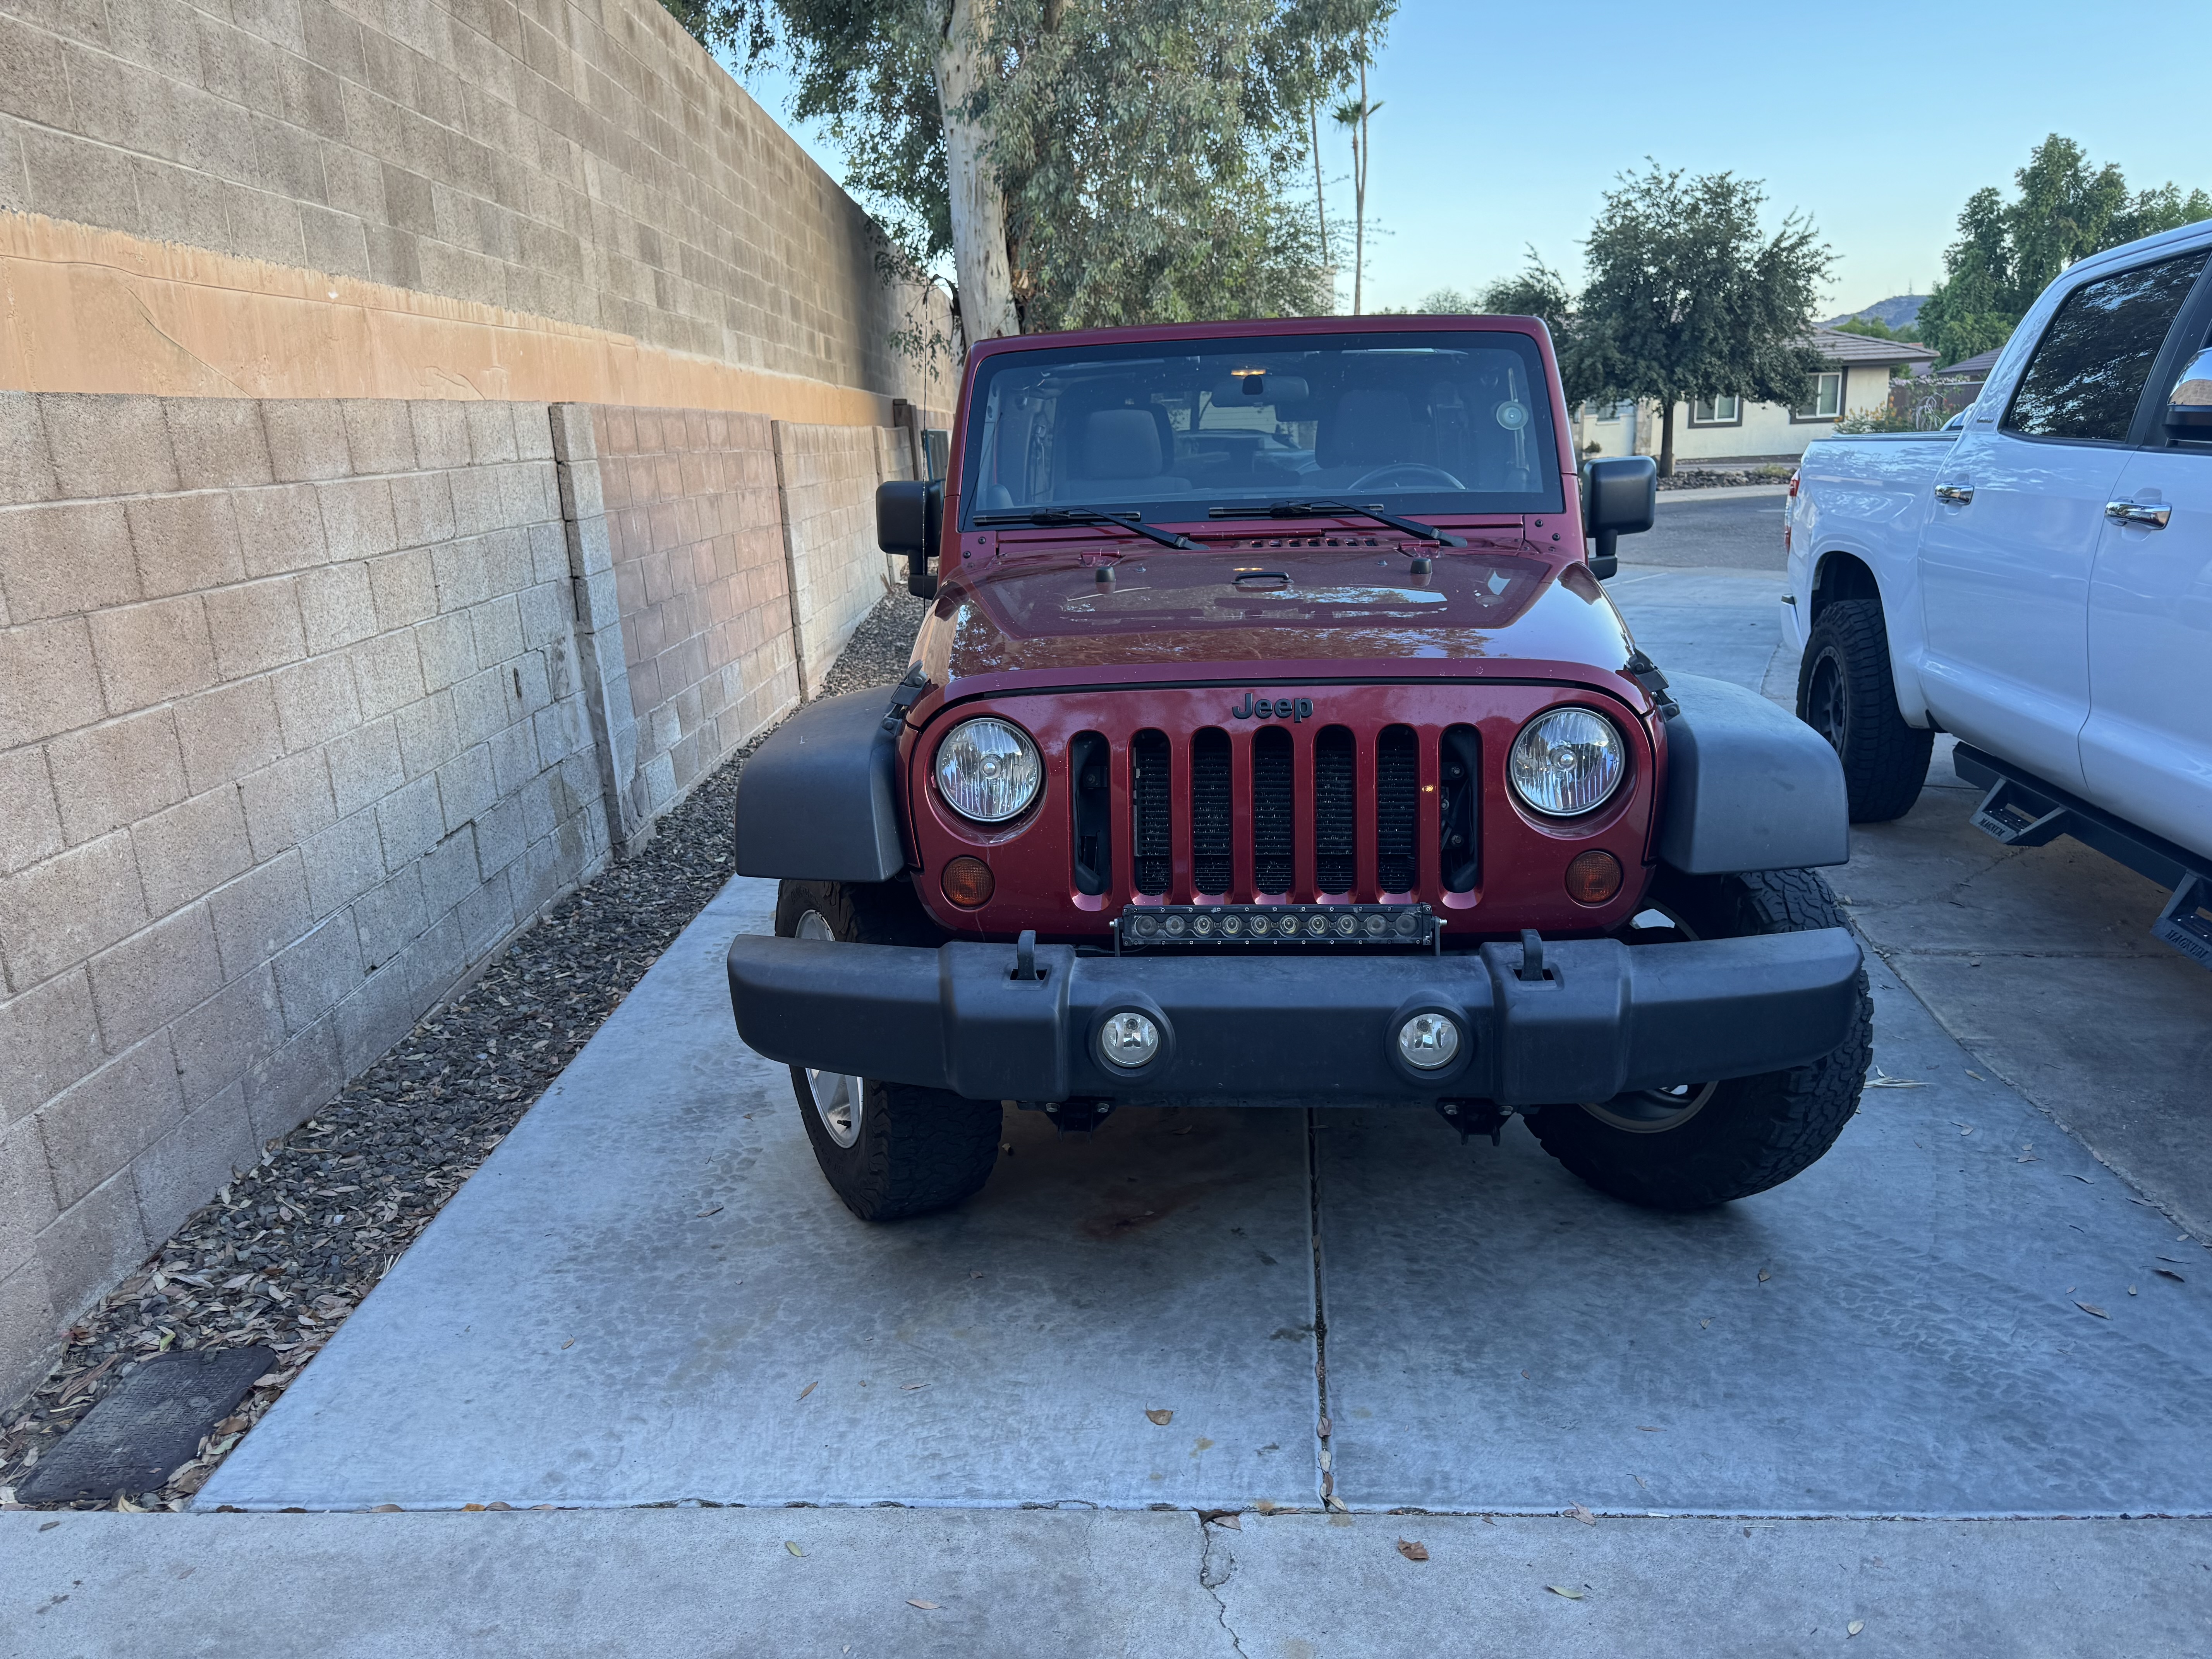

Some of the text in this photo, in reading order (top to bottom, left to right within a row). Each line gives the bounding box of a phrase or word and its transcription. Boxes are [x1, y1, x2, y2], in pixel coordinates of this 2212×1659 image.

[1232, 692, 1314, 723] Jeep
[1978, 817, 2006, 837] MAGNUM
[2164, 929, 2209, 958] MAGNUM
